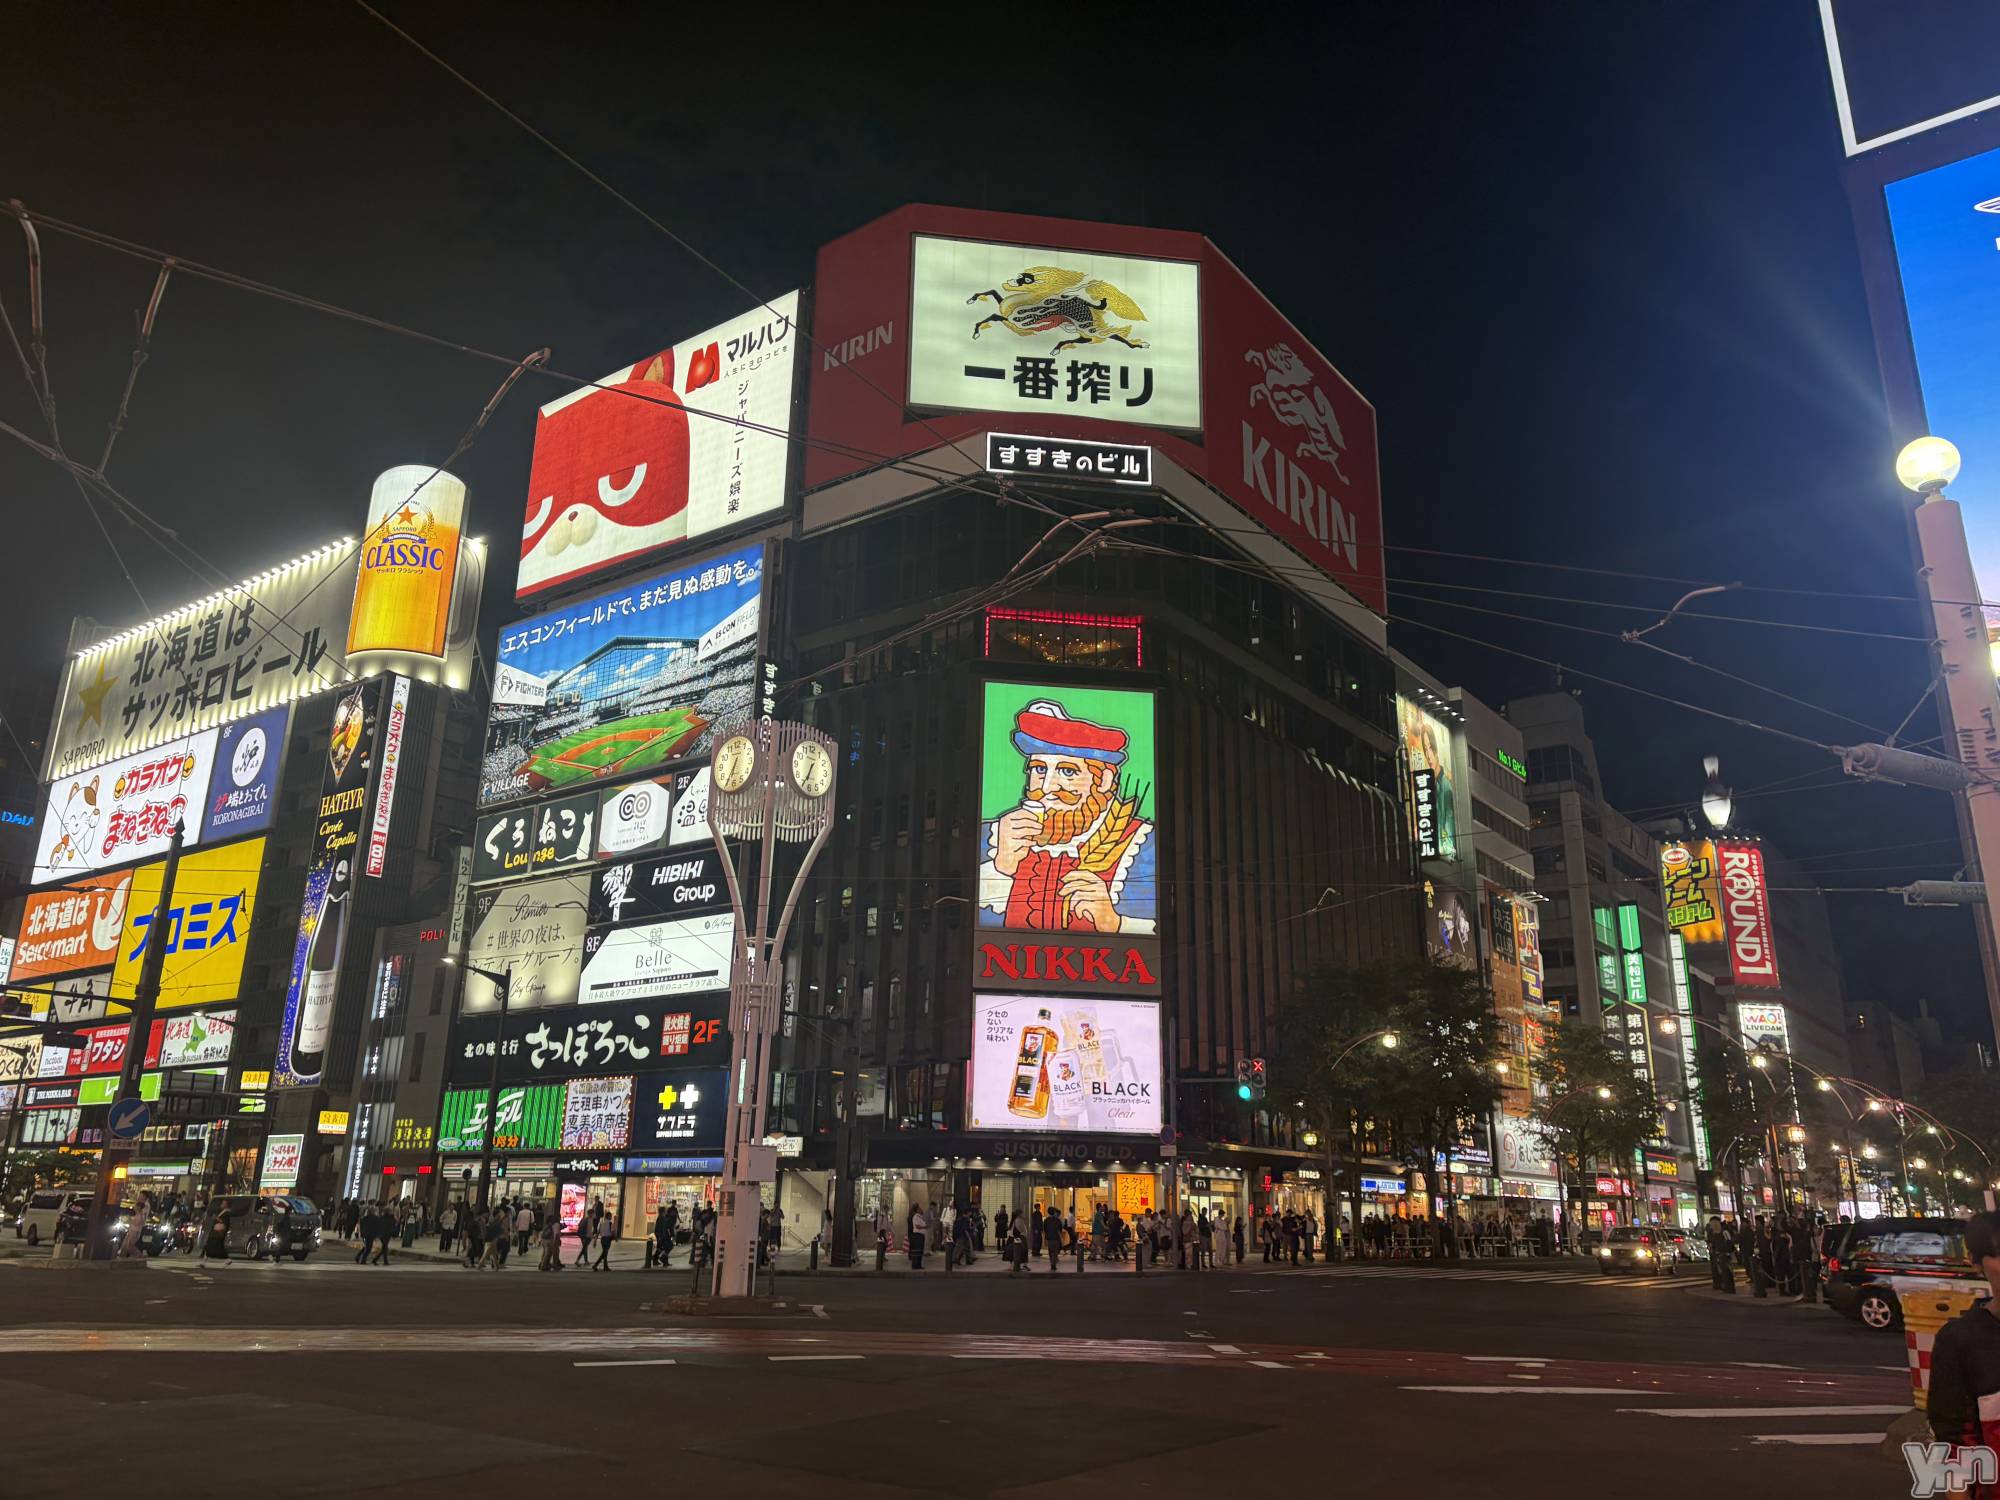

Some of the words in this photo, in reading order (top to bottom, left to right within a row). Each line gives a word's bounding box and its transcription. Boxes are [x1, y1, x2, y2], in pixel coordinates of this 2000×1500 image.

[726, 315, 790, 362] マルハン
[823, 321, 895, 372] KIRIN
[964, 356, 1154, 407] 一番搾り
[998, 444, 1141, 475] すすきのビル
[1242, 420, 1358, 573] KIRIN
[365, 543, 444, 571] CLASSIC
[503, 559, 755, 654] エスコンフィールドで、まだ見ぬ感動を。
[129, 599, 254, 688] 北海道は
[120, 626, 328, 740] サッポロビール
[514, 680, 545, 697] FIGHTERS
[223, 726, 233, 739] 8F
[61, 738, 105, 767] SAPPORO
[124, 753, 185, 797] カラオケ
[490, 773, 530, 794] VILLAGE
[678, 776, 691, 790] 2F
[212, 802, 265, 826] KORONAGIRAI
[319, 787, 364, 818] HATHYR
[101, 794, 188, 858] まねきねこ
[1415, 773, 1436, 857] すすきのビル
[325, 832, 358, 850] Capella
[484, 807, 577, 861] くろねこ
[504, 847, 555, 869] Lounge
[651, 860, 704, 885] HIBIKI
[673, 883, 715, 904] Group
[28, 896, 91, 937] 北海道は
[450, 882, 467, 943] グリーンビル
[478, 898, 491, 914] 9F
[17, 930, 89, 965] Seicomart
[586, 936, 601, 953] 8F
[635, 950, 672, 969] Belle
[978, 943, 1157, 985] NIKKA
[986, 1010, 1008, 1018] クセの
[986, 1018, 1002, 1026] ない
[1744, 1012, 1782, 1026] WAO!
[693, 1019, 721, 1044] 2F
[986, 1026, 1014, 1034] クリアな
[986, 1034, 1009, 1042] 味わい
[525, 1014, 650, 1070] さっぽろっこ
[162, 1049, 172, 1064] 1F
[1053, 1081, 1082, 1092] BLACK
[1092, 1082, 1151, 1097] BLACK
[569, 1094, 622, 1113] 元祖串かつ
[1107, 1107, 1136, 1119] Clear
[567, 1112, 627, 1131] 恵美須商店
[657, 1115, 696, 1130] サツドラ
[992, 1142, 1088, 1159] SUSUKINO
[1095, 1143, 1137, 1160] BLD.
